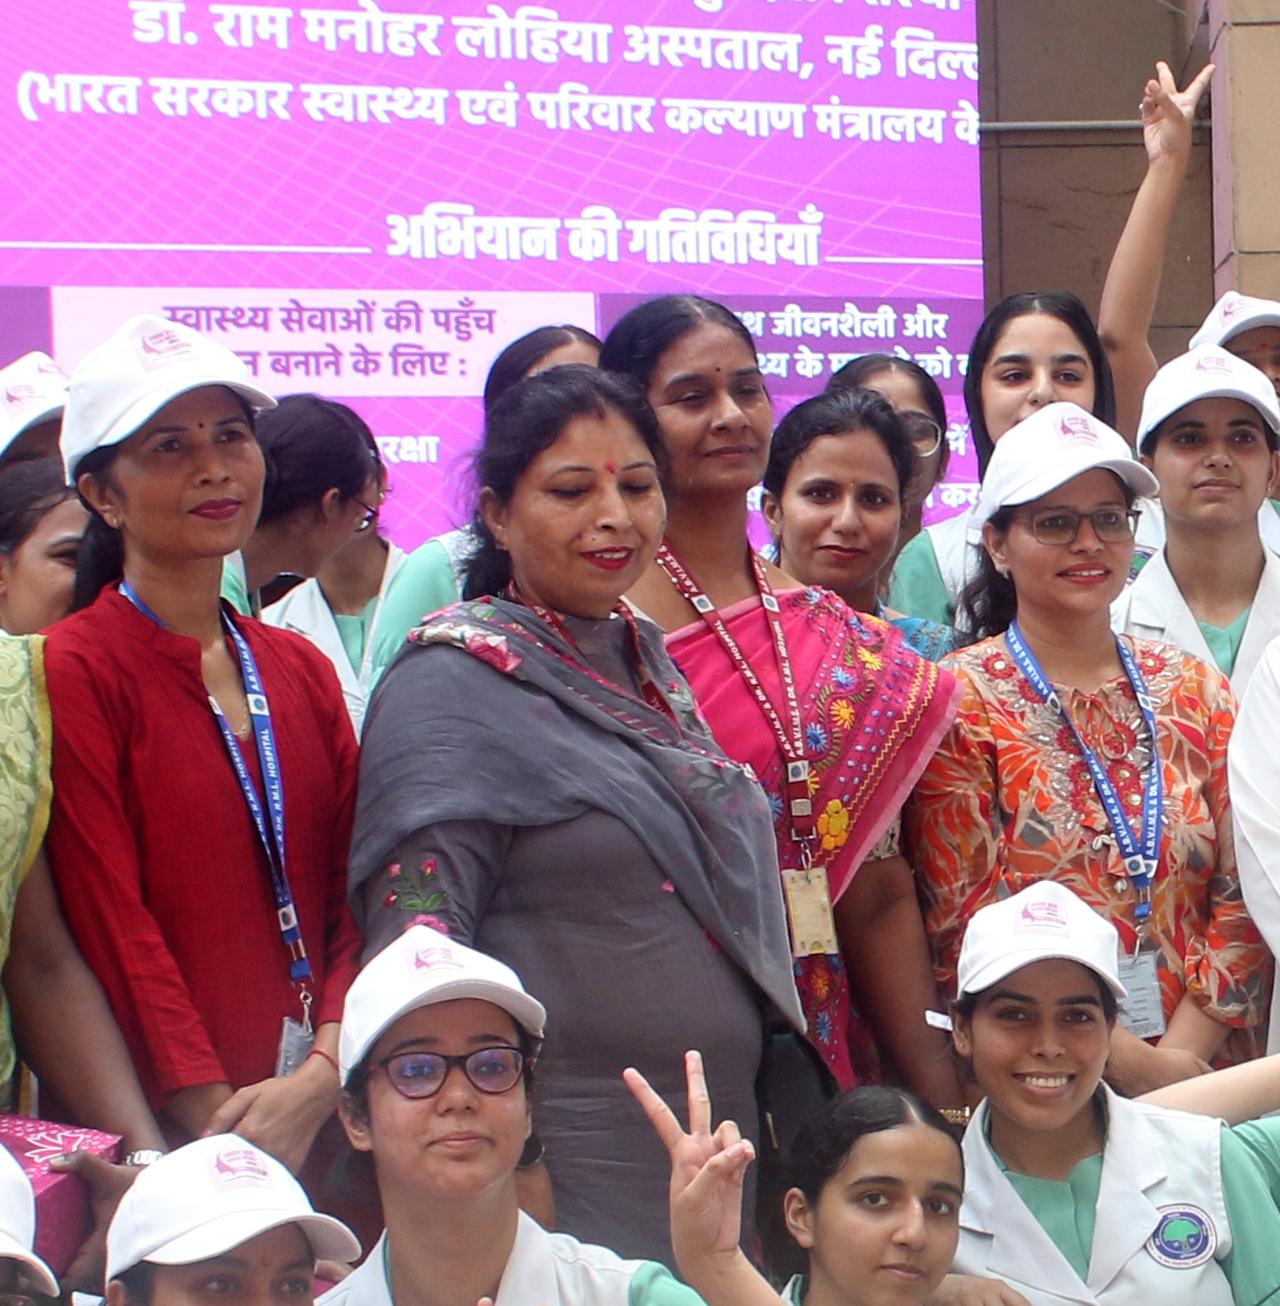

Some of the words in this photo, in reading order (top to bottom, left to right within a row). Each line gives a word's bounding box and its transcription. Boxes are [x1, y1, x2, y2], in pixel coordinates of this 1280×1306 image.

[209, 4, 293, 49] राम
[300, 0, 444, 57] मनोहर
[452, 5, 613, 63] लोहिया
[624, 24, 815, 80] अस्पताल,
[825, 25, 884, 80] नई
[17, 70, 142, 121] (भारत
[149, 78, 294, 120] सरकार
[300, 84, 449, 125] स्वास्थ्य
[455, 82, 519, 127] एवं
[527, 82, 656, 133] परिवार
[662, 98, 806, 139] कल्याण
[814, 95, 947, 144] मंत्रालय
[386, 202, 561, 260] अभियान
[564, 205, 621, 262] की
[626, 203, 824, 266] गतिविधियाँ
[162, 304, 271, 333] स्वास्थ्य
[280, 298, 377, 335] सेवाओं
[384, 299, 424, 335] की
[432, 297, 496, 342] पहुँच
[770, 302, 897, 338] जीवनशैली
[902, 303, 950, 339] और
[269, 343, 342, 376] बनाने
[350, 343, 381, 376] के
[389, 345, 450, 378] लिए
[793, 345, 825, 378] के
[374, 435, 441, 464] रक्षा
[714, 619, 743, 661] HOSPITAL
[260, 728, 275, 778] HOSPITAL
